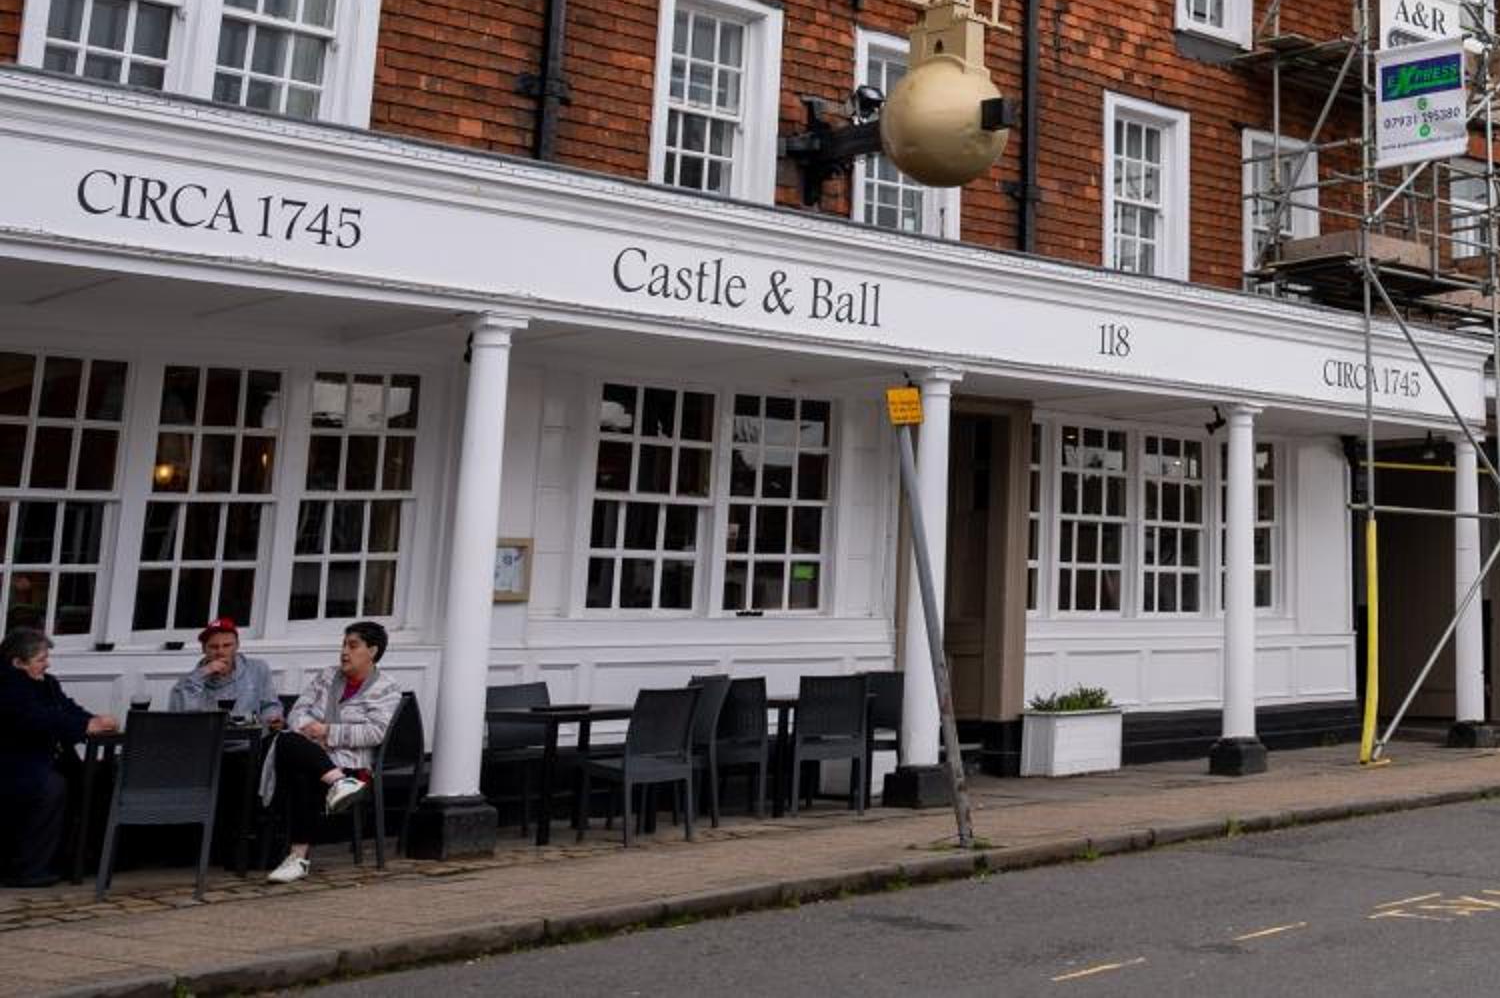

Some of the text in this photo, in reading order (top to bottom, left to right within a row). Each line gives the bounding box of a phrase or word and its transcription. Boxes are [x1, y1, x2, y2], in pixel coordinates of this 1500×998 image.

[77, 169, 362, 249] CIRCA 1745
[613, 247, 881, 327] Castle & Ball
[1098, 324, 1131, 358] 118
[1382, 364, 1421, 398] 1745
